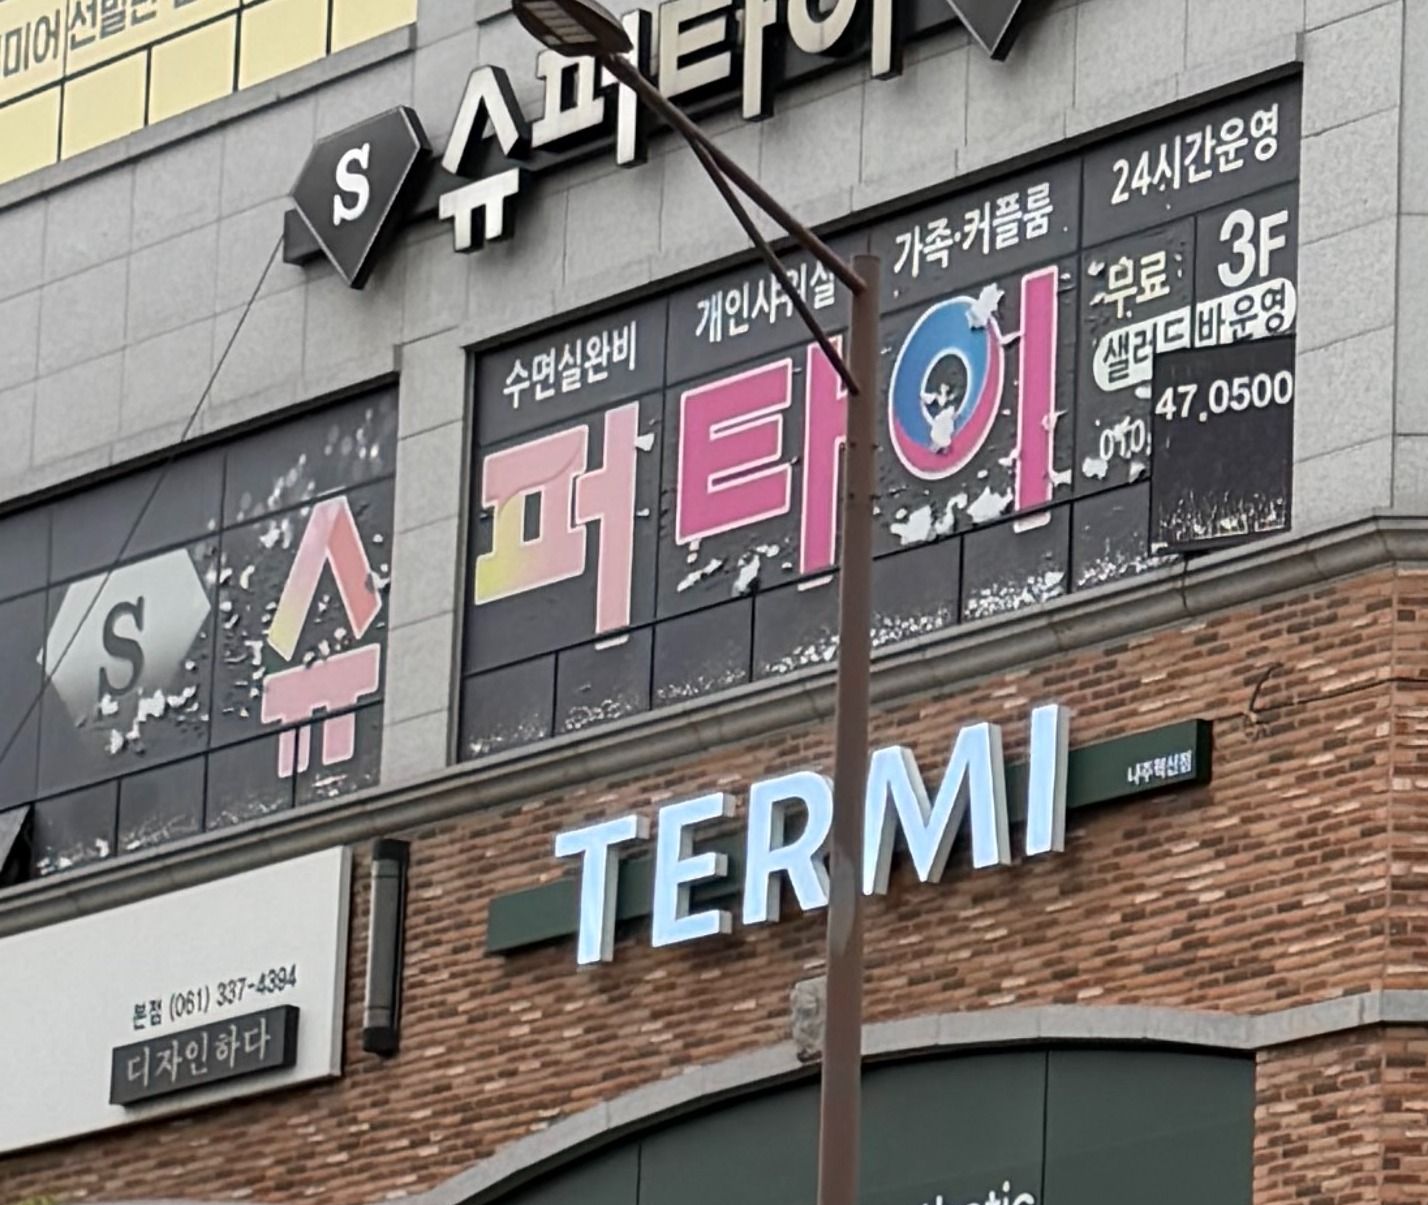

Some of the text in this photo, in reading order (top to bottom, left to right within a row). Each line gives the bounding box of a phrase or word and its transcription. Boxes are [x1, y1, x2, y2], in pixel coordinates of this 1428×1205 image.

[332, 142, 371, 226] S
[1111, 103, 1279, 205] 24시간운영
[1217, 208, 1289, 288] 3F
[503, 321, 637, 410] 수면실완비
[554, 703, 1070, 968] TERMI
[169, 985, 210, 1022] (061)
[216, 963, 297, 1007] 337-4394
[127, 1017, 271, 1088] 디자인하다
